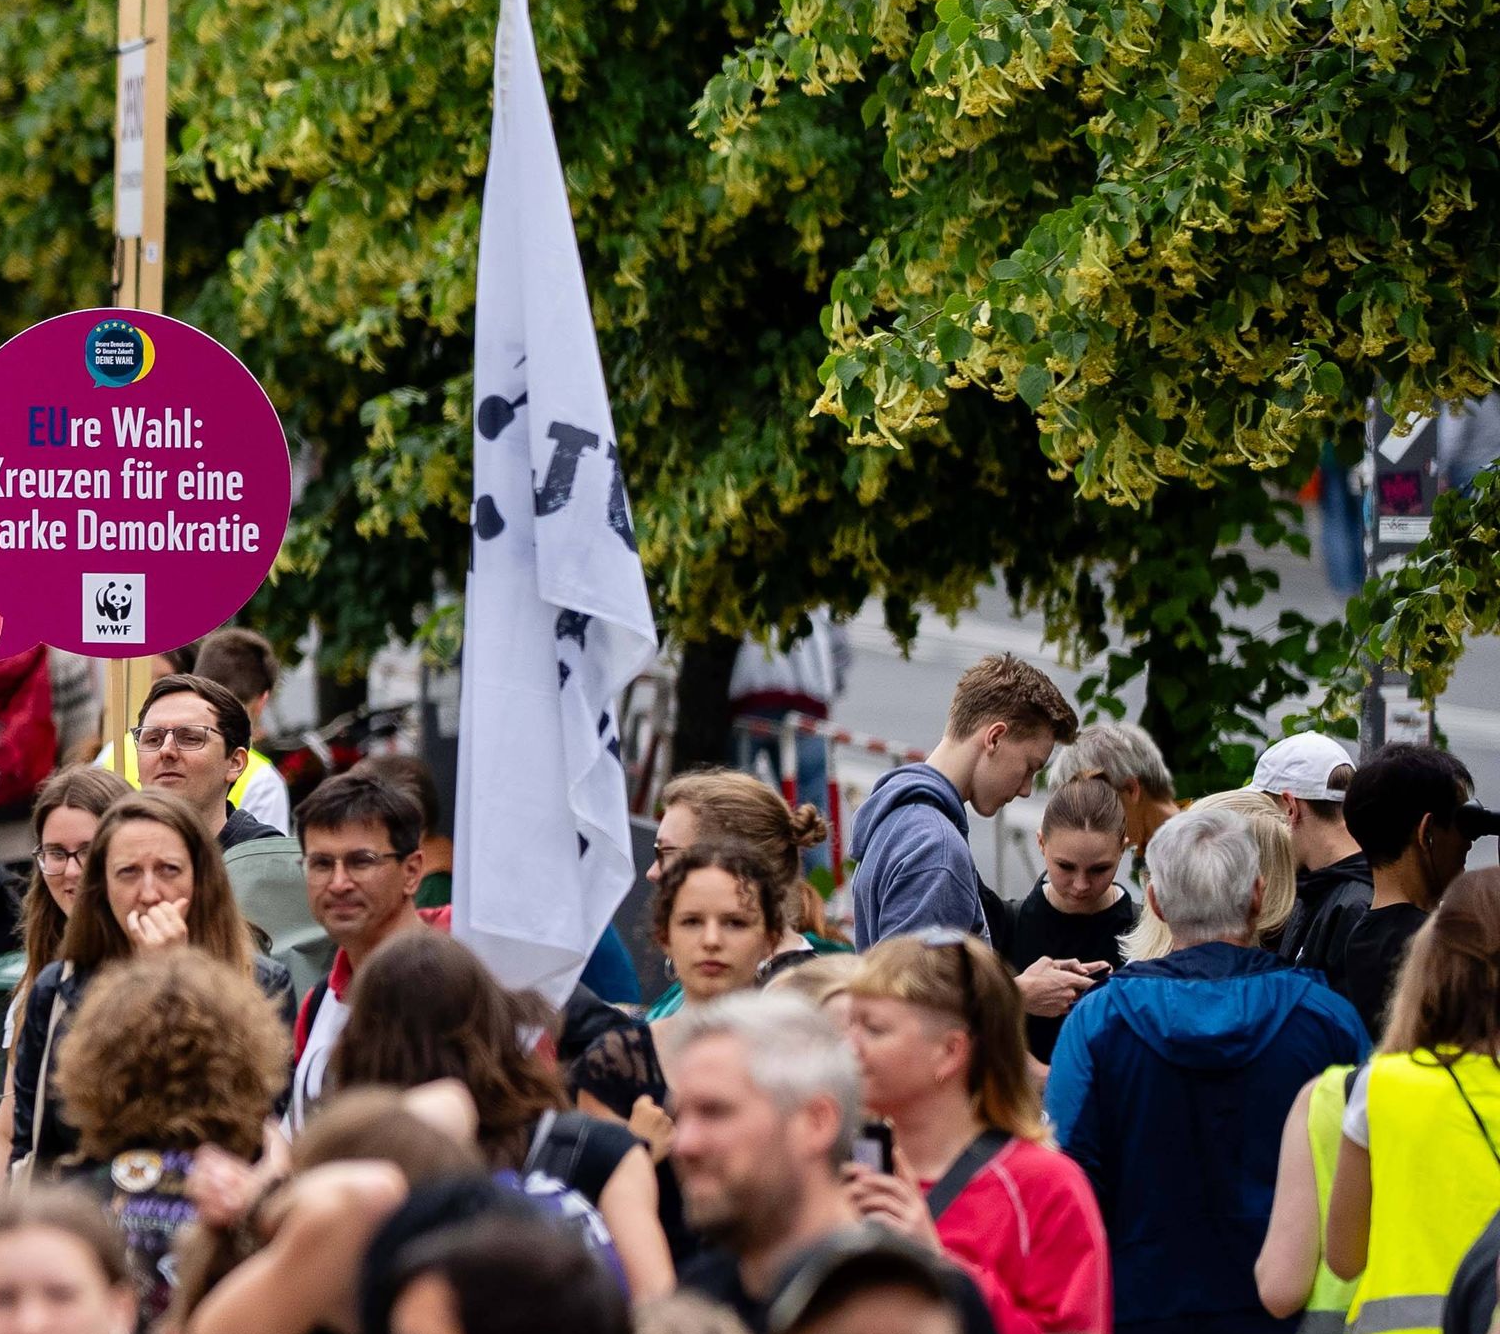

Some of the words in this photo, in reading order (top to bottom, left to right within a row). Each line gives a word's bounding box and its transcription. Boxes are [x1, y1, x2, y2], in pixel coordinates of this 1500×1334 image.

[95, 356, 114, 365] DEINE
[115, 356, 134, 365] WAHL
[28, 406, 102, 448] EUre
[111, 407, 203, 449] Wahl:
[121, 458, 168, 500] für
[177, 462, 244, 501] eine
[77, 510, 260, 552] Demokratie
[96, 624, 131, 635] WWF
